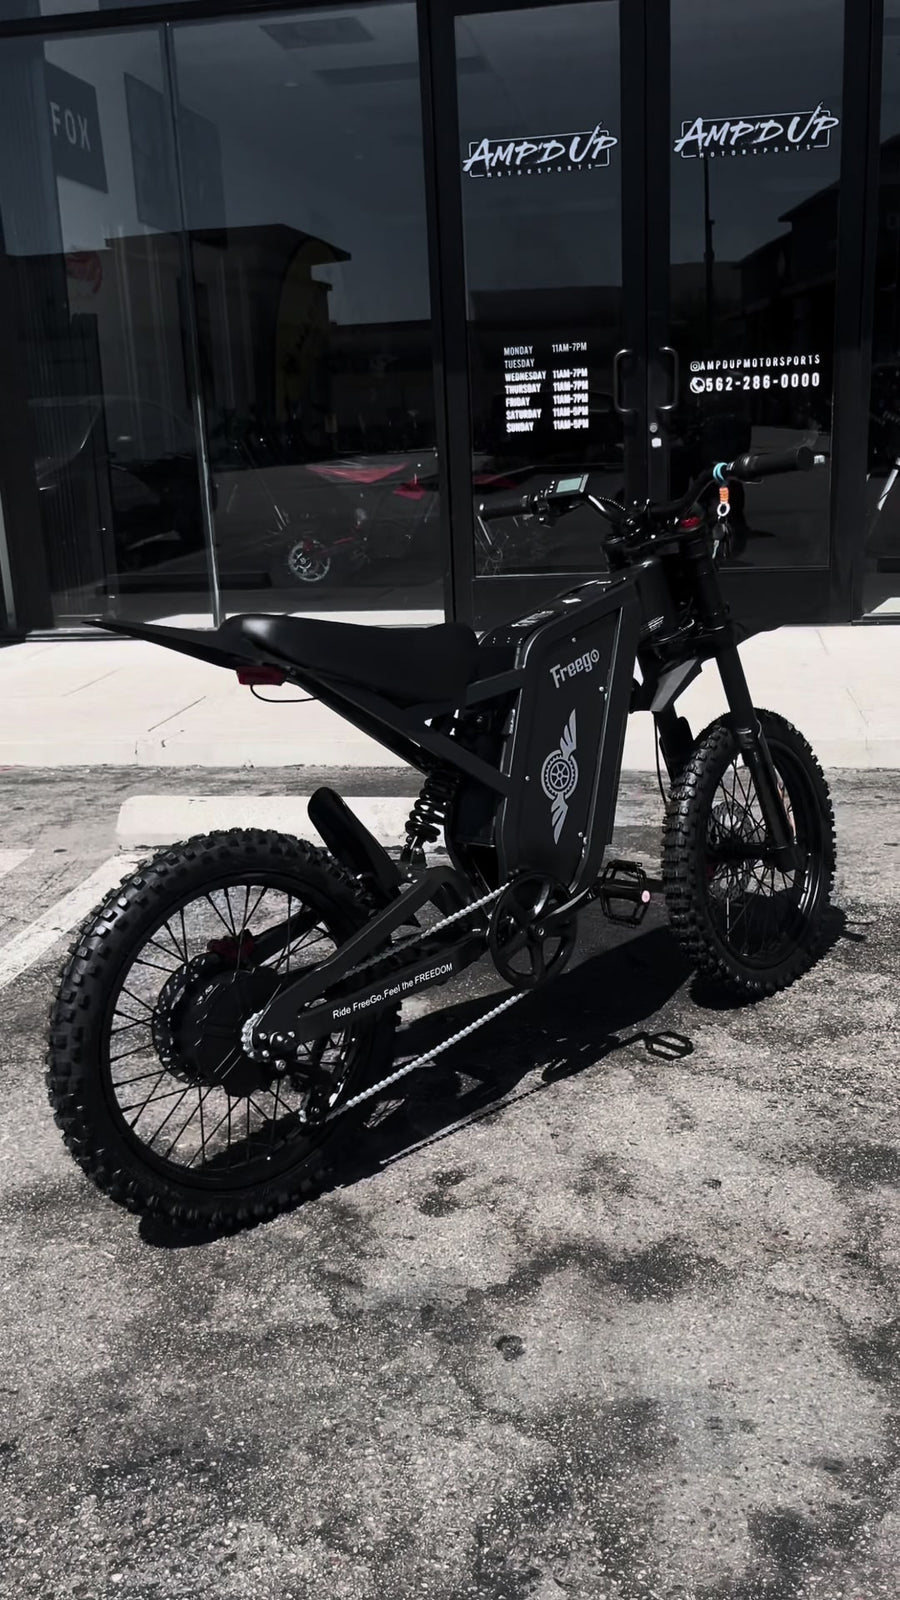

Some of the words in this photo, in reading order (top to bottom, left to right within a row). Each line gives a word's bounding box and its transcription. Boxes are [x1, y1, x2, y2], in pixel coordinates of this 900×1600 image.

[50, 101, 91, 152] FOX
[672, 117, 784, 153] AMP'D
[787, 101, 840, 143] UP
[462, 138, 566, 172] AMP'D
[569, 121, 618, 163] UP
[699, 143, 811, 158] MOTORSPORTS
[503, 345, 533, 356] MONDAY
[552, 341, 587, 353] 11AM-7PM
[504, 358, 535, 369] TUESDAY
[504, 370, 547, 382] WEDNESDAY
[552, 367, 588, 379] 11AM-7PM
[705, 372, 820, 392] 562-286-0000
[504, 382, 541, 395] THURSDAY
[552, 380, 589, 392] 11AM-7PM
[505, 396, 531, 408] FRIDAY
[552, 392, 589, 405] 11AM-7PM
[505, 408, 542, 421] SATURDAY
[505, 421, 534, 433] SUNDAY
[549, 649, 600, 688] Freego
[332, 1006, 352, 1019] Ride
[383, 984, 401, 998] Feel
[401, 980, 414, 991] the
[414, 962, 453, 984] FREEDOM
